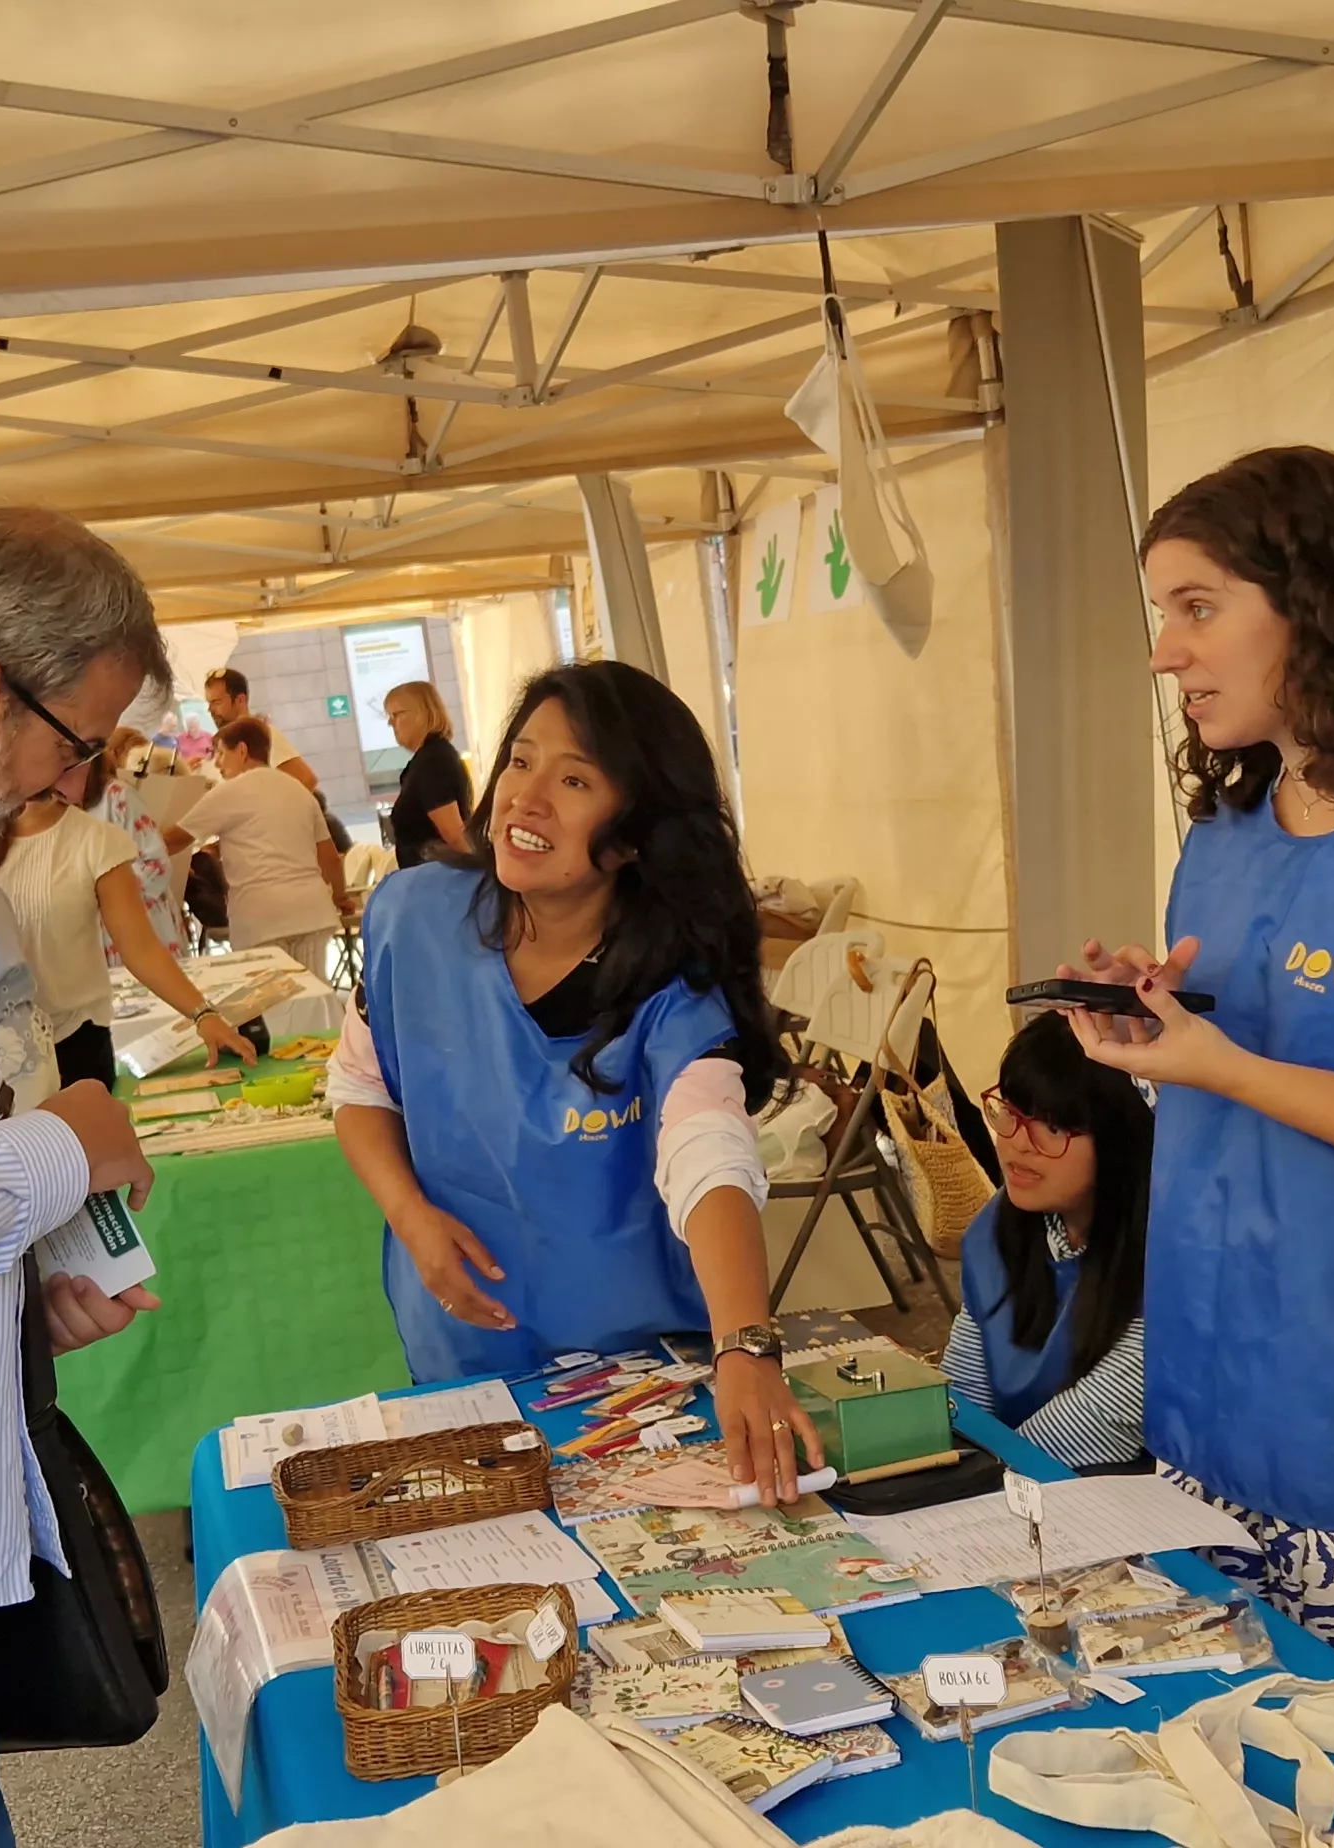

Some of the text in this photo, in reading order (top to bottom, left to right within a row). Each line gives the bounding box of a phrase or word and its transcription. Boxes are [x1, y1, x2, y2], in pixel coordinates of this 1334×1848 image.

[564, 1096, 641, 1133] DOWN
[320, 1552, 354, 1586] Lotería
[331, 1586, 355, 1600] de
[410, 1641, 465, 1655] LIBRETITAS
[430, 1656, 436, 1670] 2
[938, 1671, 973, 1686] BOLSA
